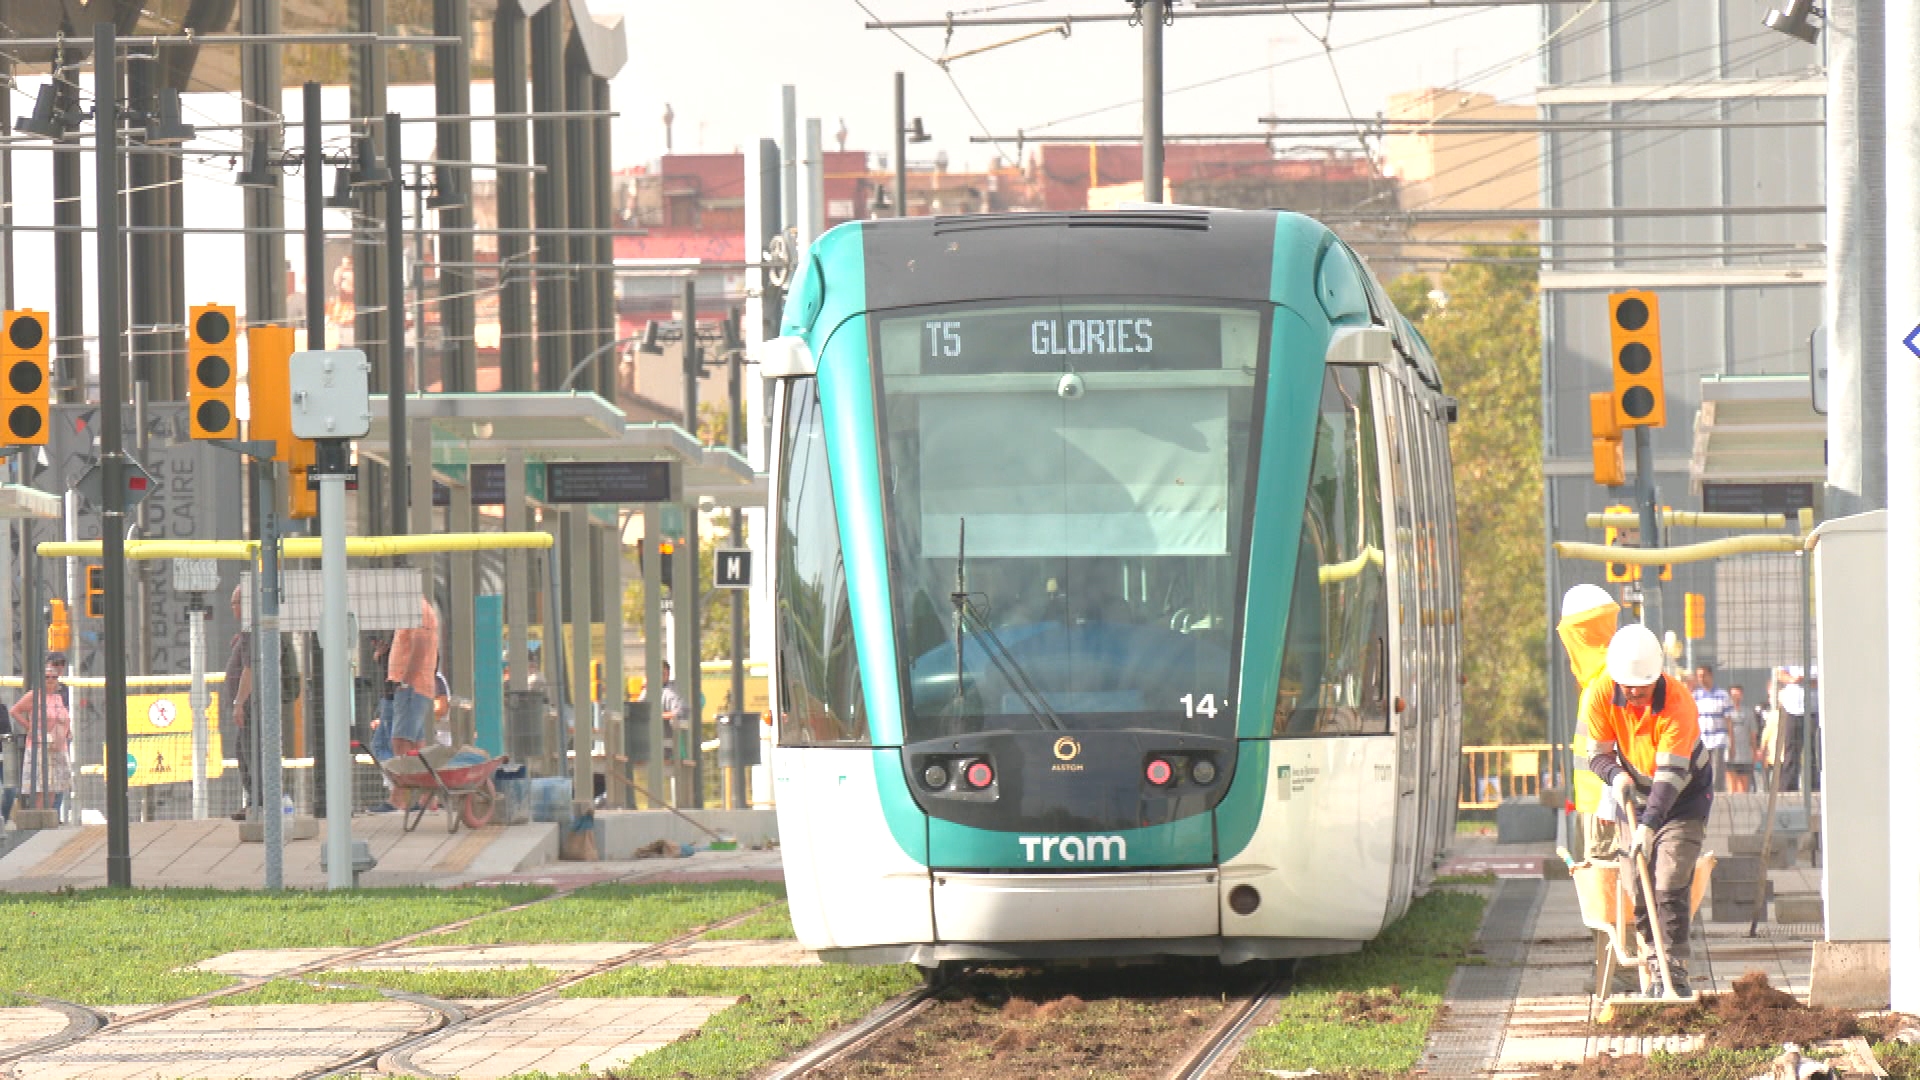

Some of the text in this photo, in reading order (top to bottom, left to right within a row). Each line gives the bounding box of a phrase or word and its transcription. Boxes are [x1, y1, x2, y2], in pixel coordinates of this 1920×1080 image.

[926, 318, 1153, 356] T5 GLORIES
[727, 556, 741, 580] M
[1180, 694, 1218, 718] 14
[1018, 835, 1126, 862] Tram
